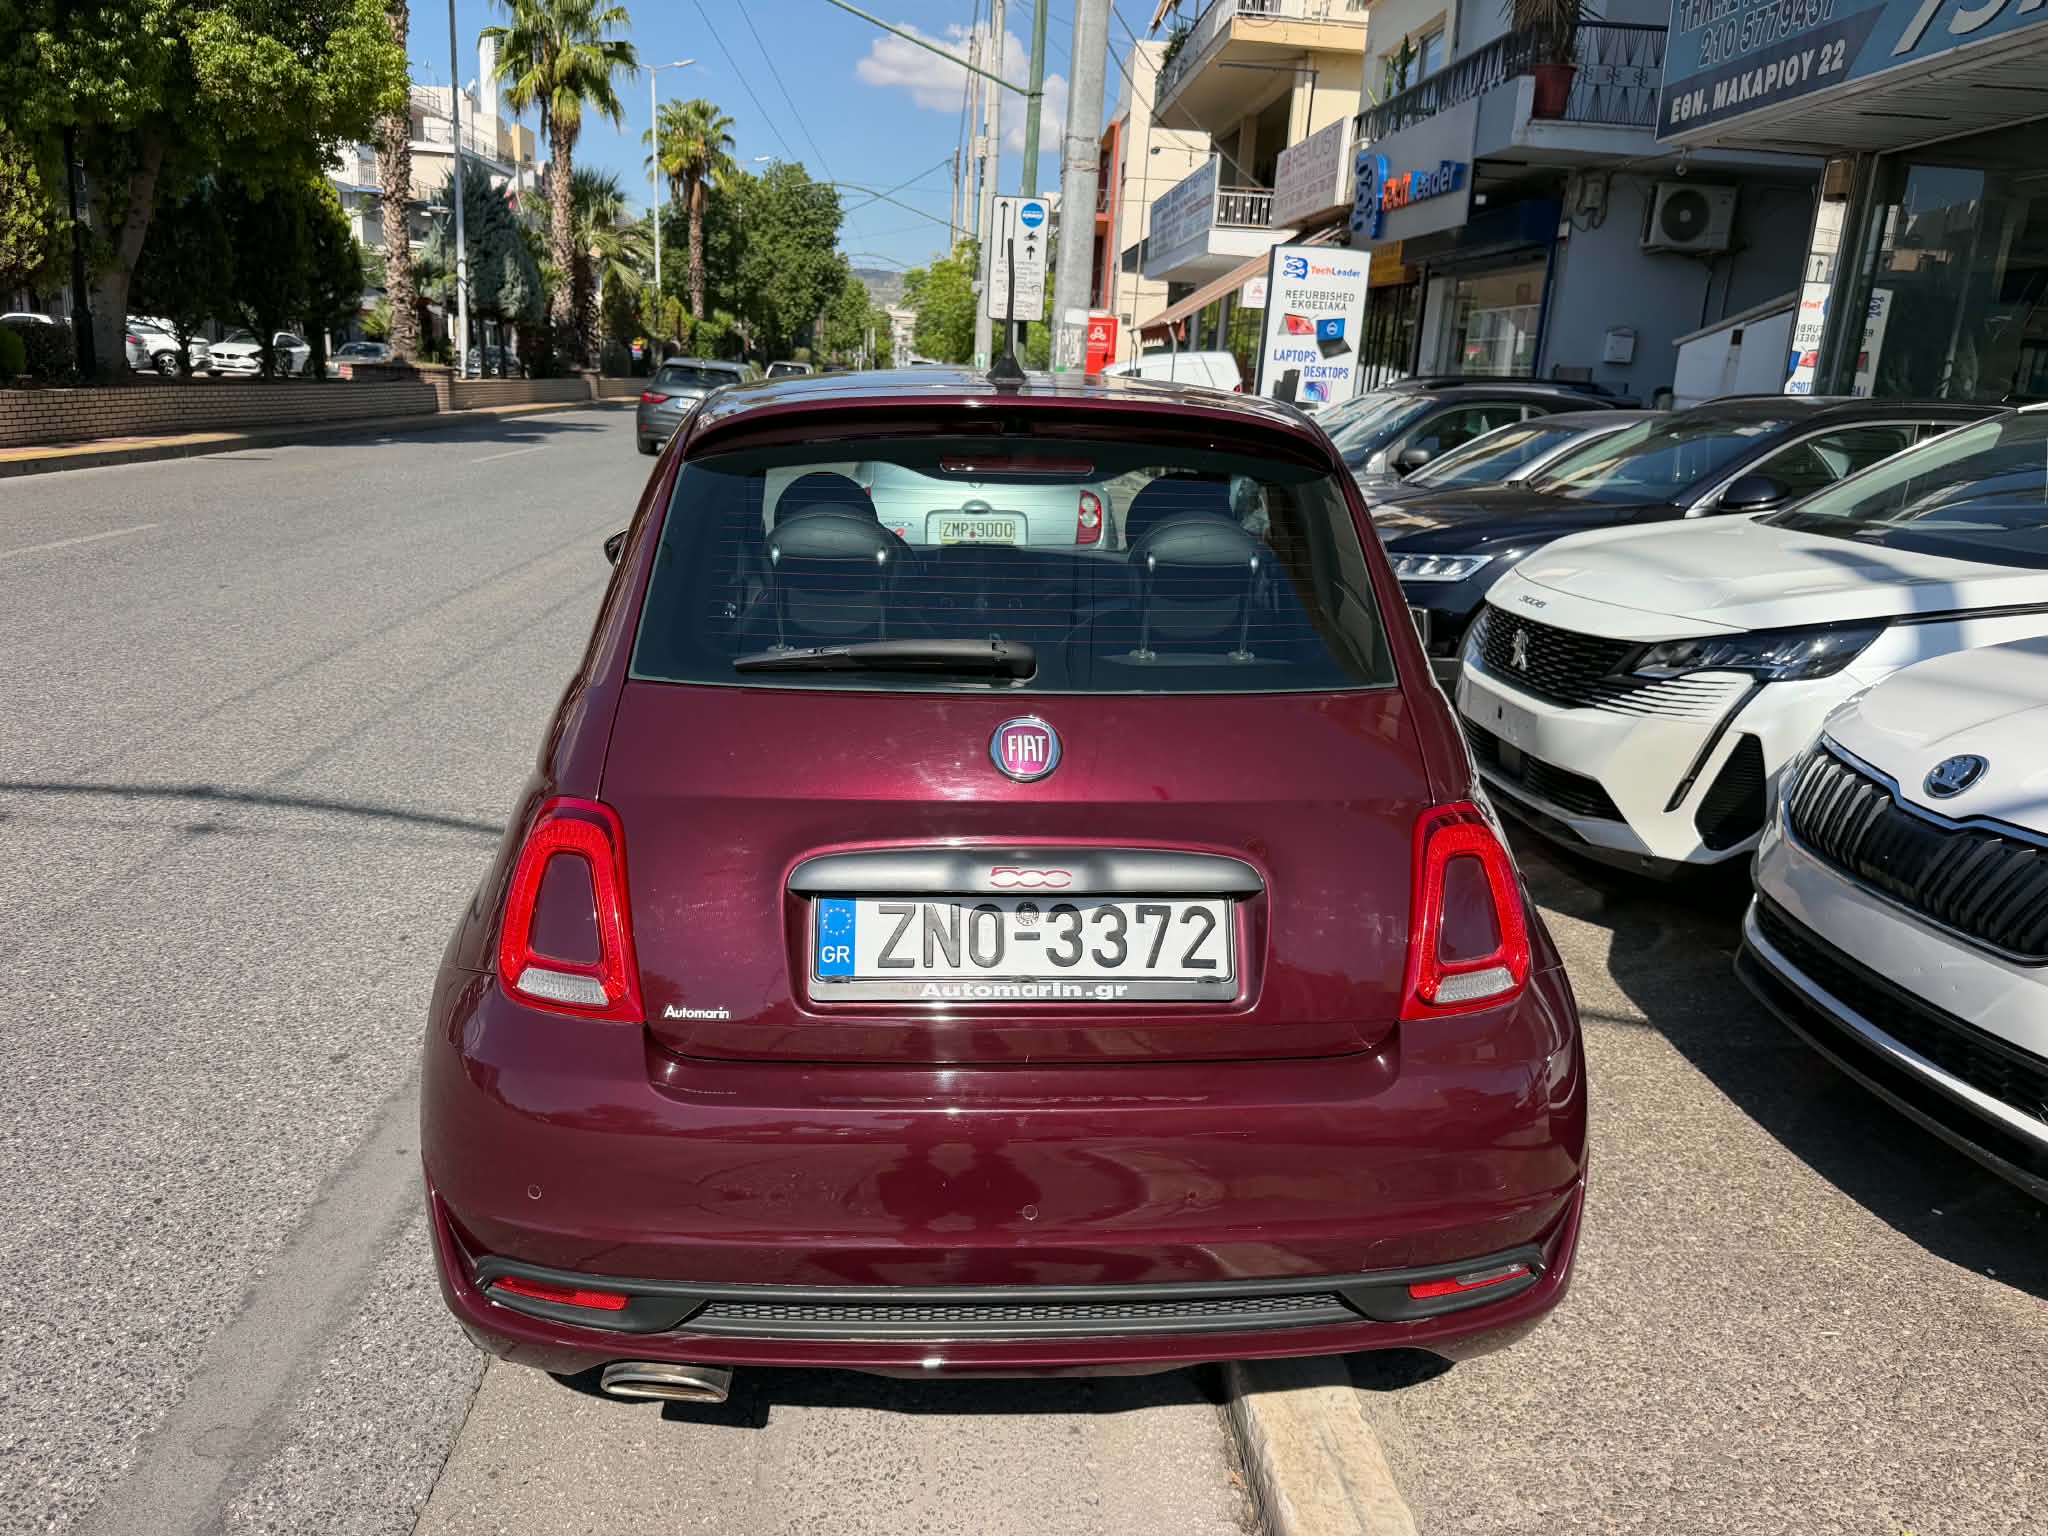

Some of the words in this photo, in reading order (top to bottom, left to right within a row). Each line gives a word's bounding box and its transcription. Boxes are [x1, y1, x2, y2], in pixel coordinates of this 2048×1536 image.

[1697, 19, 1737, 68] 210
[1670, 88, 1708, 125] ΕΘΝ.
[1712, 48, 1816, 111] ΜΑΚΑΡΙΟΥ
[1817, 39, 1846, 76] 22
[1311, 265, 1361, 277] TechLeader
[1285, 289, 1355, 302] REFURBISHED
[1273, 349, 1317, 363] LAPTOPS
[1304, 366, 1349, 380] DESKTOPS
[1007, 735, 1046, 762] FIAT
[991, 867, 1072, 888] 500
[877, 903, 1217, 969] ZNO-3372
[821, 945, 850, 964] GR
[919, 981, 1129, 999] Automarin.gr
[663, 1004, 730, 1019] Automarin
